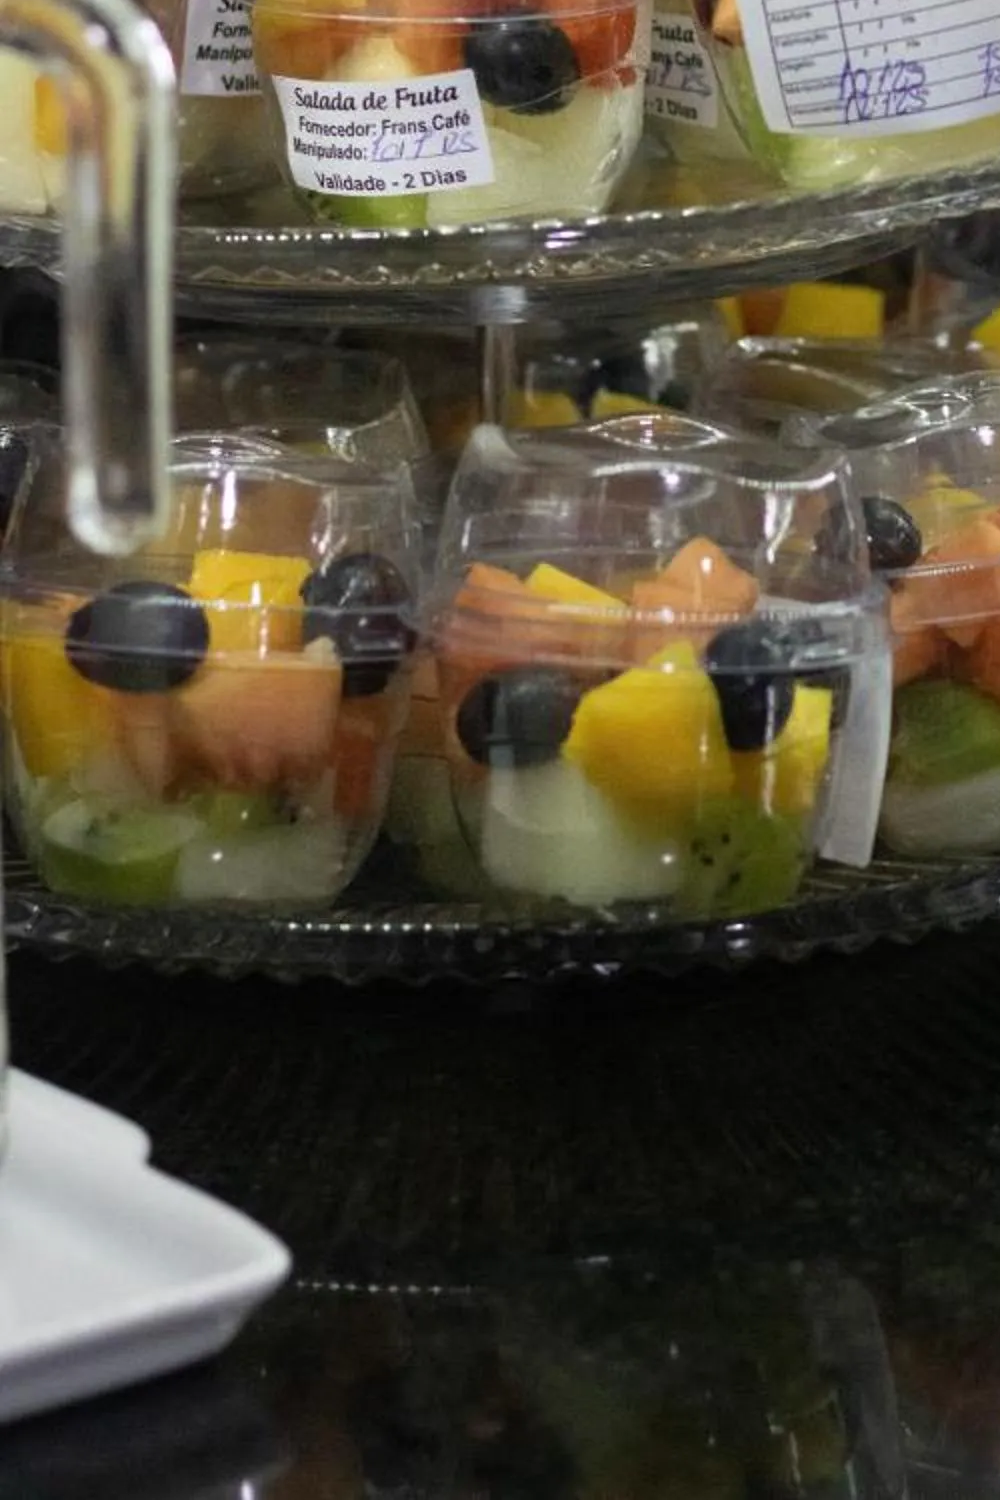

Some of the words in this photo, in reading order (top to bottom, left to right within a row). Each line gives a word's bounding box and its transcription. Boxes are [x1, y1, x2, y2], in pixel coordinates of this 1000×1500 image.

[195, 44, 253, 65] Manipu
[221, 74, 259, 92] Vali
[293, 86, 356, 111] Salada
[362, 91, 387, 110] de
[395, 85, 459, 109] Fruta
[381, 118, 427, 137] Frans
[431, 109, 471, 131] Café
[293, 137, 368, 162] Manipulado:
[314, 170, 386, 192] Validade
[403, 173, 417, 189] 2
[421, 168, 468, 188] Dias
